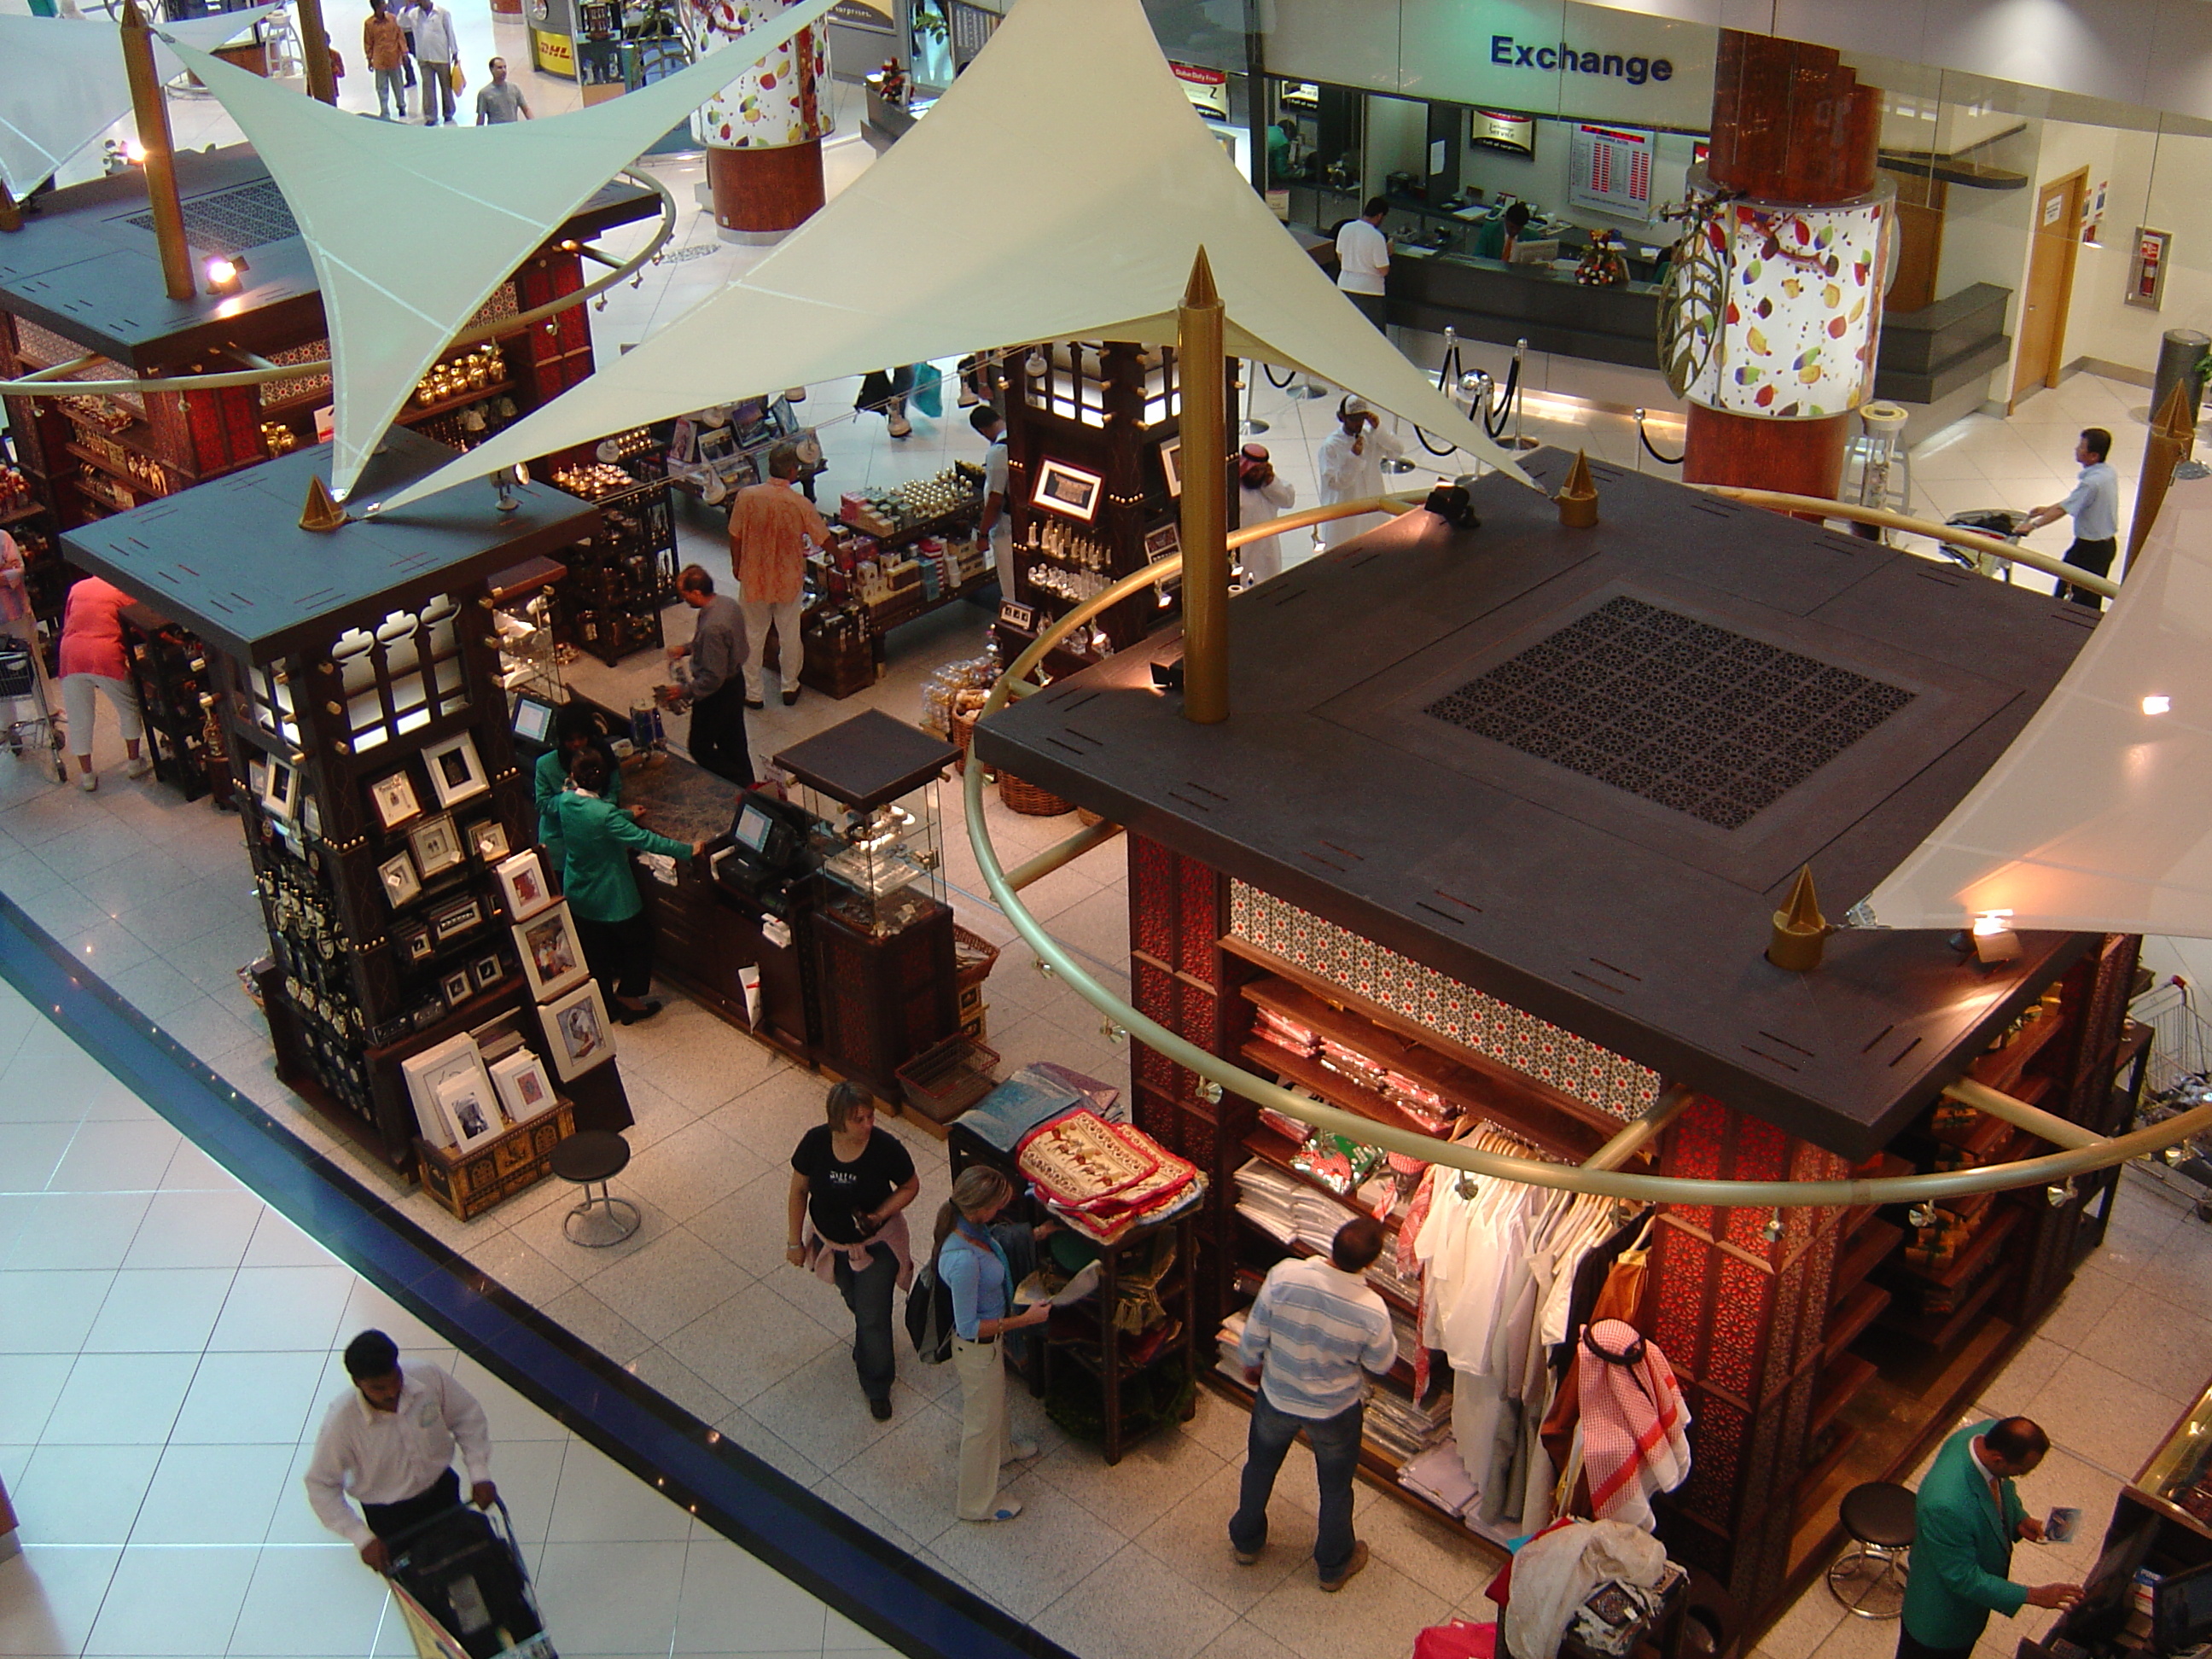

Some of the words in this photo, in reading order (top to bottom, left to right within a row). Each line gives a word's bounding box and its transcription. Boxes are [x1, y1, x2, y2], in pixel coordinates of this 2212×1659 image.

[540, 41, 571, 60] DHL
[1491, 34, 1674, 85] Exchange
[1192, 71, 1205, 81] Duty
[1490, 129, 1515, 137] Service
